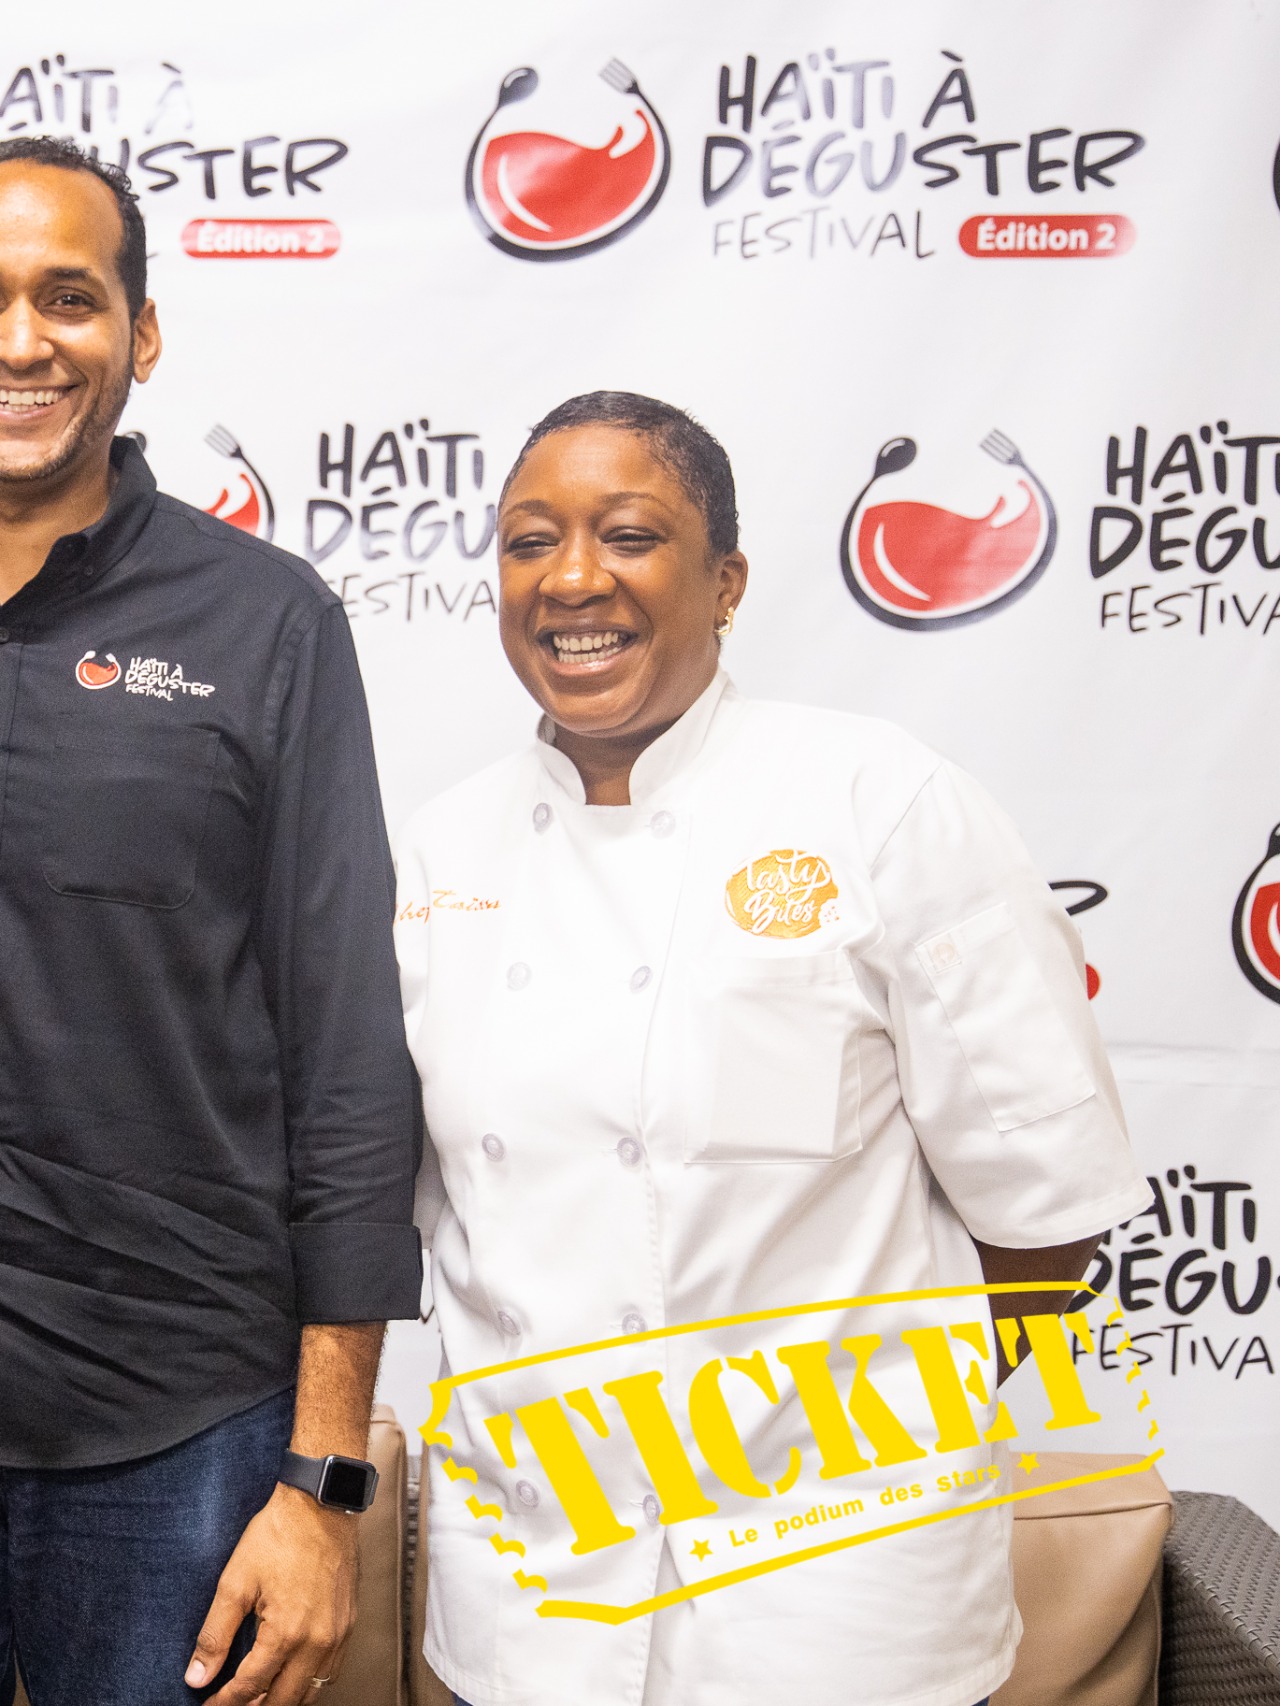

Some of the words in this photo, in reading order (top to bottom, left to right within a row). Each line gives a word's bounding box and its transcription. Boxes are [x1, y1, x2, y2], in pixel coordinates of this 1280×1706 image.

[144, 62, 195, 135] À
[718, 47, 895, 133] HAÏTI
[921, 49, 977, 129] À
[702, 120, 1146, 207] DÉGUSTER
[196, 221, 299, 253] Édition
[304, 227, 326, 252] 2
[712, 206, 934, 260] FESTIVAL
[976, 217, 1090, 251] Édition
[1094, 222, 1117, 251] 2
[320, 418, 484, 498] HAÏTI
[125, 668, 216, 697] DÉGUSTER
[125, 683, 174, 701] FESTIVAL
[170, 663, 183, 681] À
[732, 849, 831, 905] Tasty
[743, 888, 818, 934] Bites
